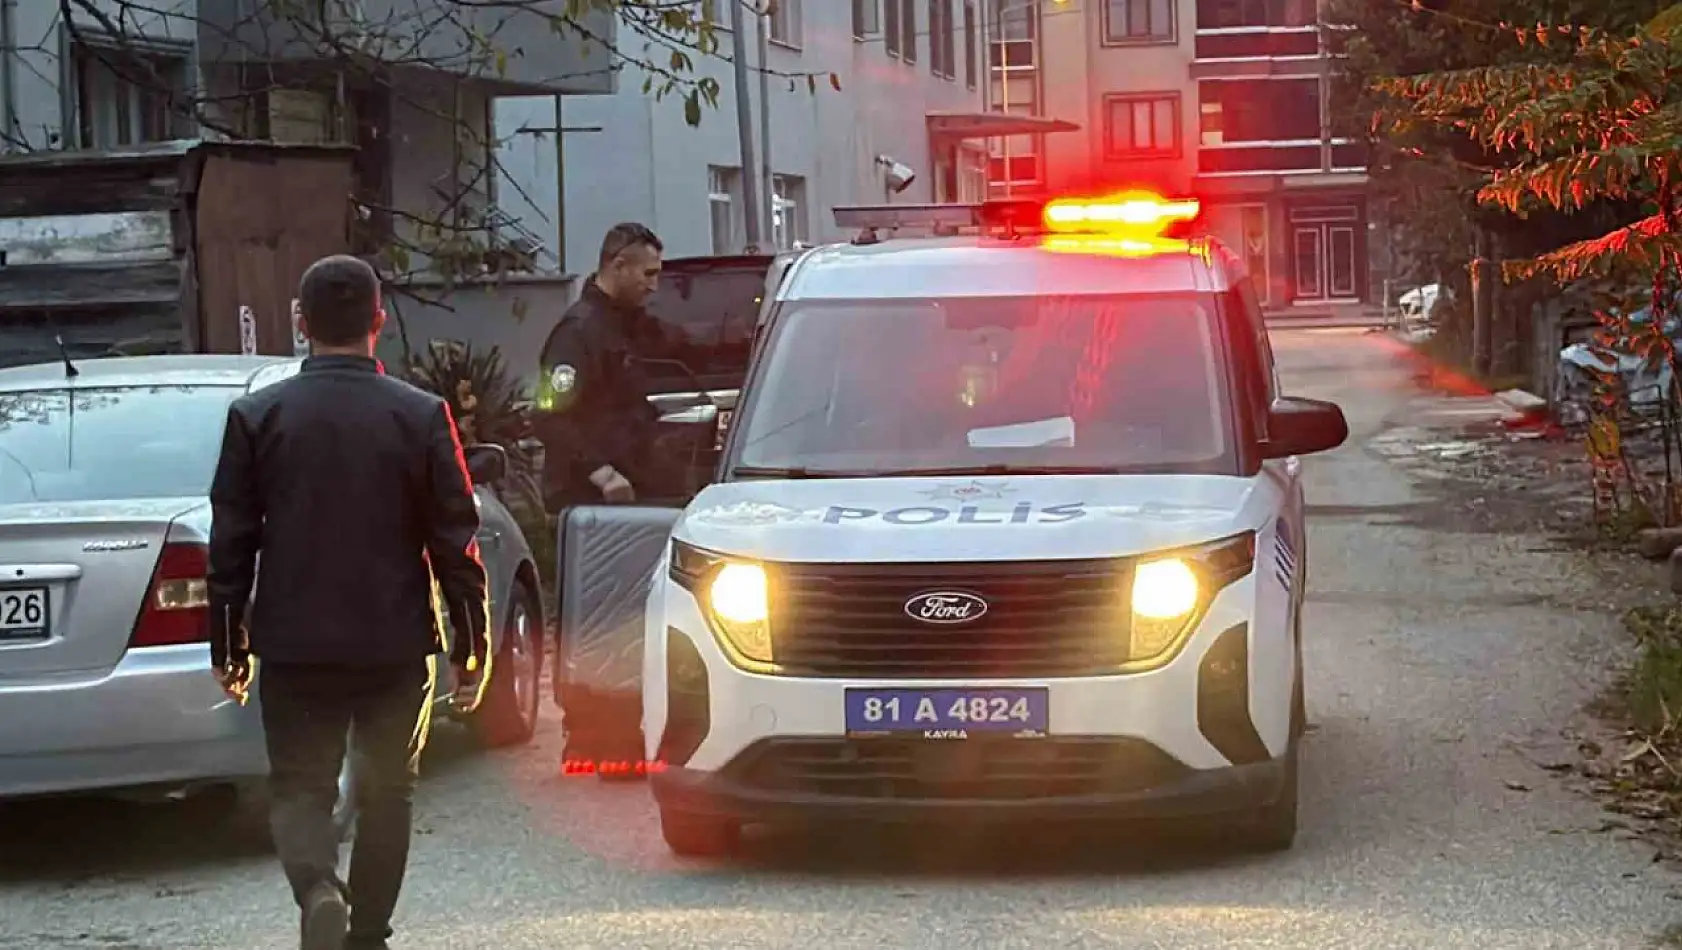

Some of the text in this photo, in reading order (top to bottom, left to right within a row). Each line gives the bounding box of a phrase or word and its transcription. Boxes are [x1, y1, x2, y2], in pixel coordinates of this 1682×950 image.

[0, 593, 41, 624] 26
[920, 595, 972, 618] Ford
[863, 696, 1030, 722] 81 A 4824
